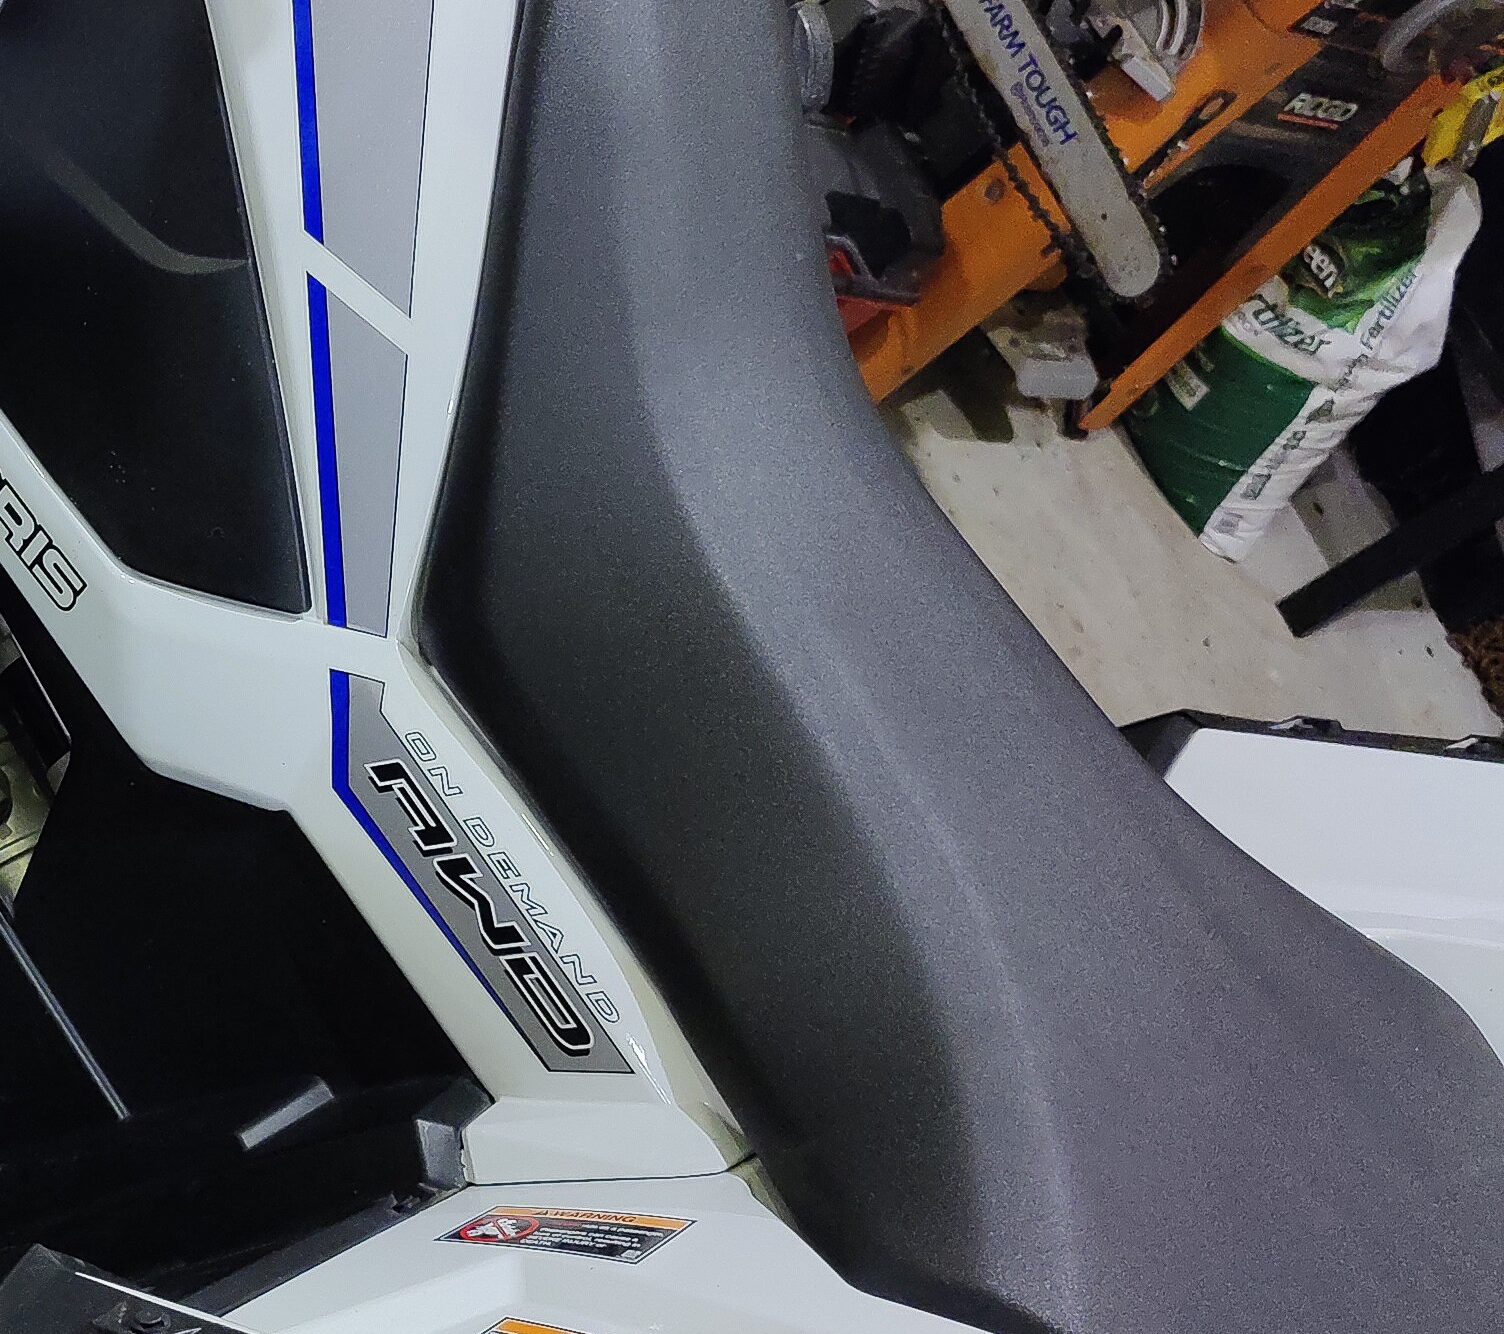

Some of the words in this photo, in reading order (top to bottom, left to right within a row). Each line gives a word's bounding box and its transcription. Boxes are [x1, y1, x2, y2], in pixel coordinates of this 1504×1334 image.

[1018, 53, 1078, 145] TOUGH
[363, 758, 595, 1057] AWD
[405, 731, 463, 797] ON
[463, 817, 620, 1023] DEMAND
[552, 1209, 637, 1223] WARNING
